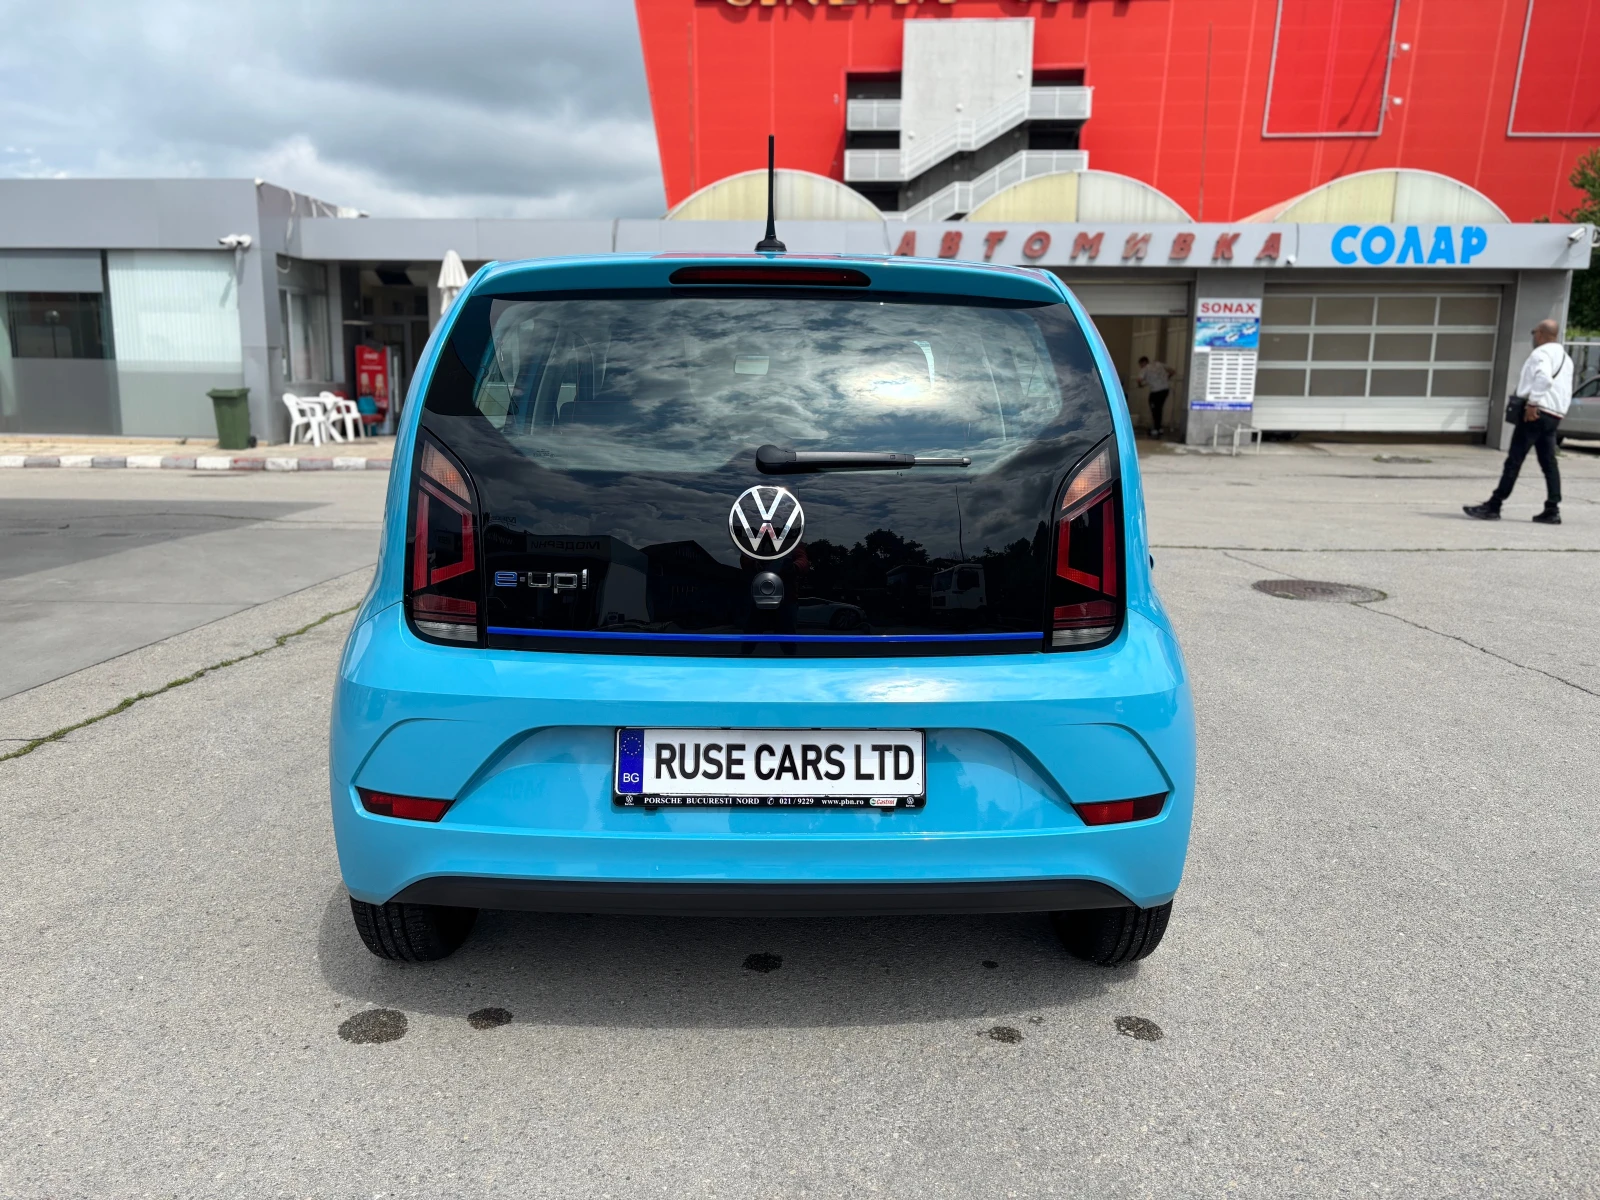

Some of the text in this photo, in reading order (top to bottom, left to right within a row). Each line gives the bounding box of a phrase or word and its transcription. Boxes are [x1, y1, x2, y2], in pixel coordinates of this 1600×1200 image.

[893, 230, 1282, 260] АВТОМИВКА
[1331, 225, 1488, 265] СОЛАР
[1201, 302, 1255, 314] SONAX
[655, 743, 915, 781] RUSE CARS LTD
[623, 773, 640, 783] BG
[644, 797, 683, 805] PORSCHE
[686, 797, 732, 805] BUCURESTI
[736, 797, 760, 805] NORD
[821, 798, 864, 807] www.pbn.ro
